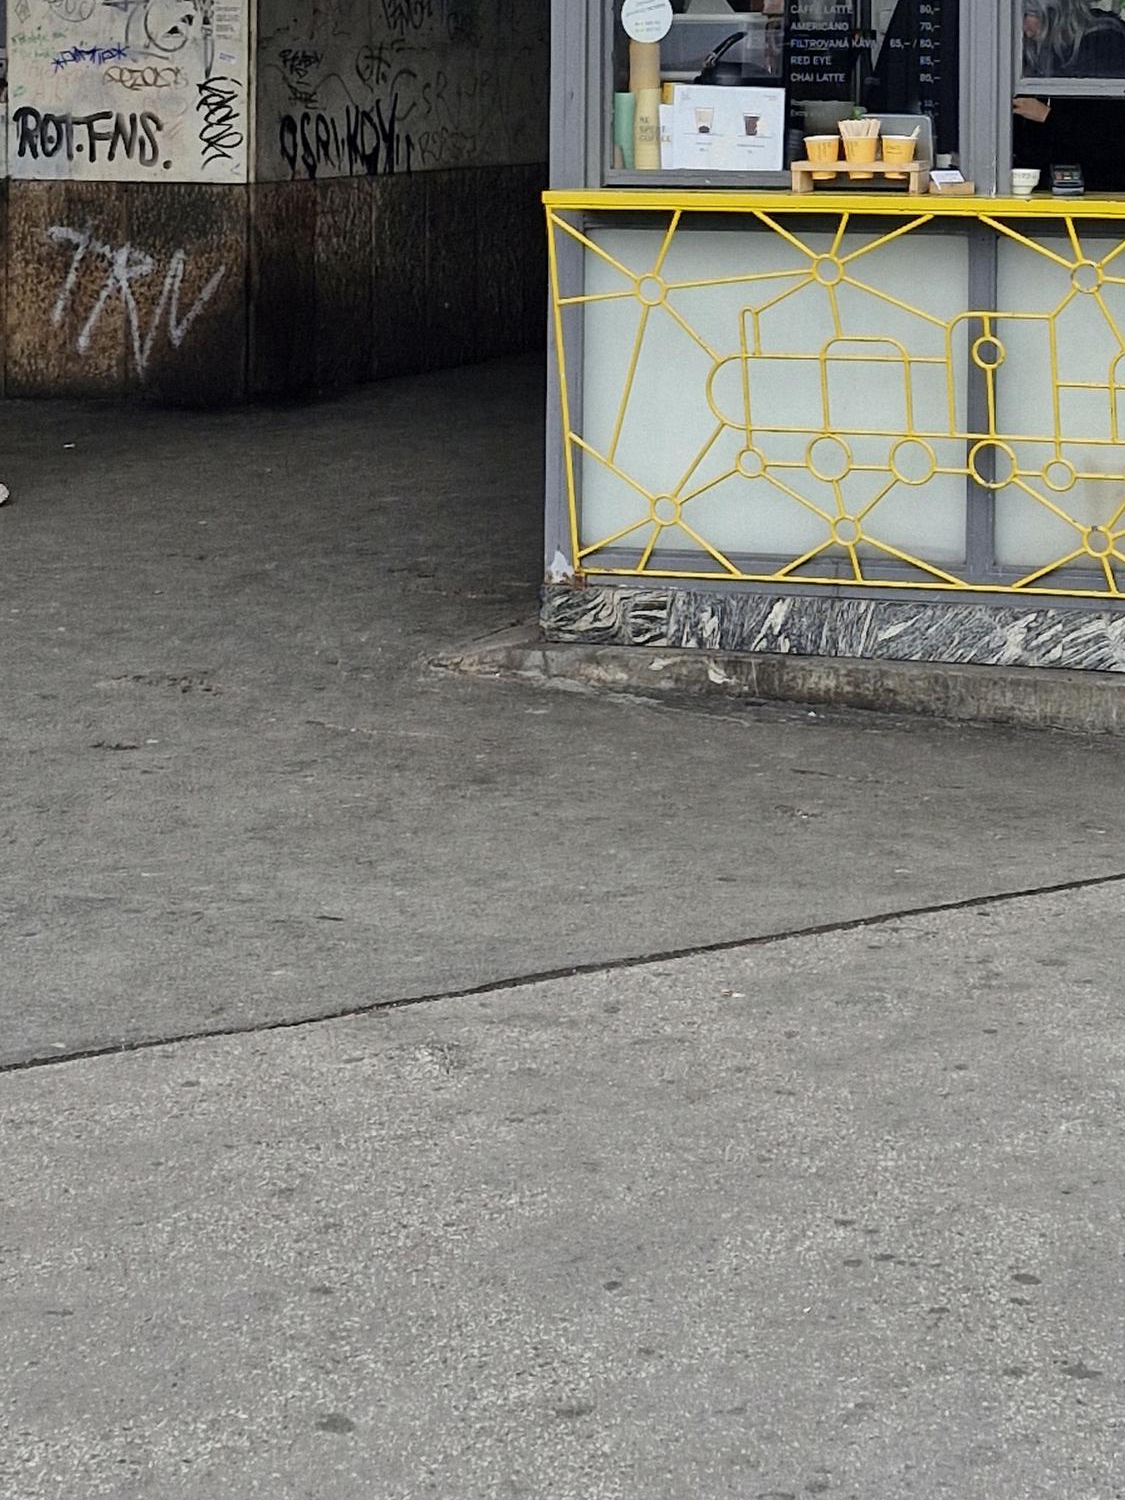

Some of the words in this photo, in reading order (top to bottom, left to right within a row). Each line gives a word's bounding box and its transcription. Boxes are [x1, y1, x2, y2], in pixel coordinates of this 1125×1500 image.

[790, 21, 849, 31] AMERICANO
[790, 56, 811, 65] RED
[813, 56, 832, 65] EYE
[790, 73, 814, 82] CHAI
[816, 73, 845, 82] LATTE
